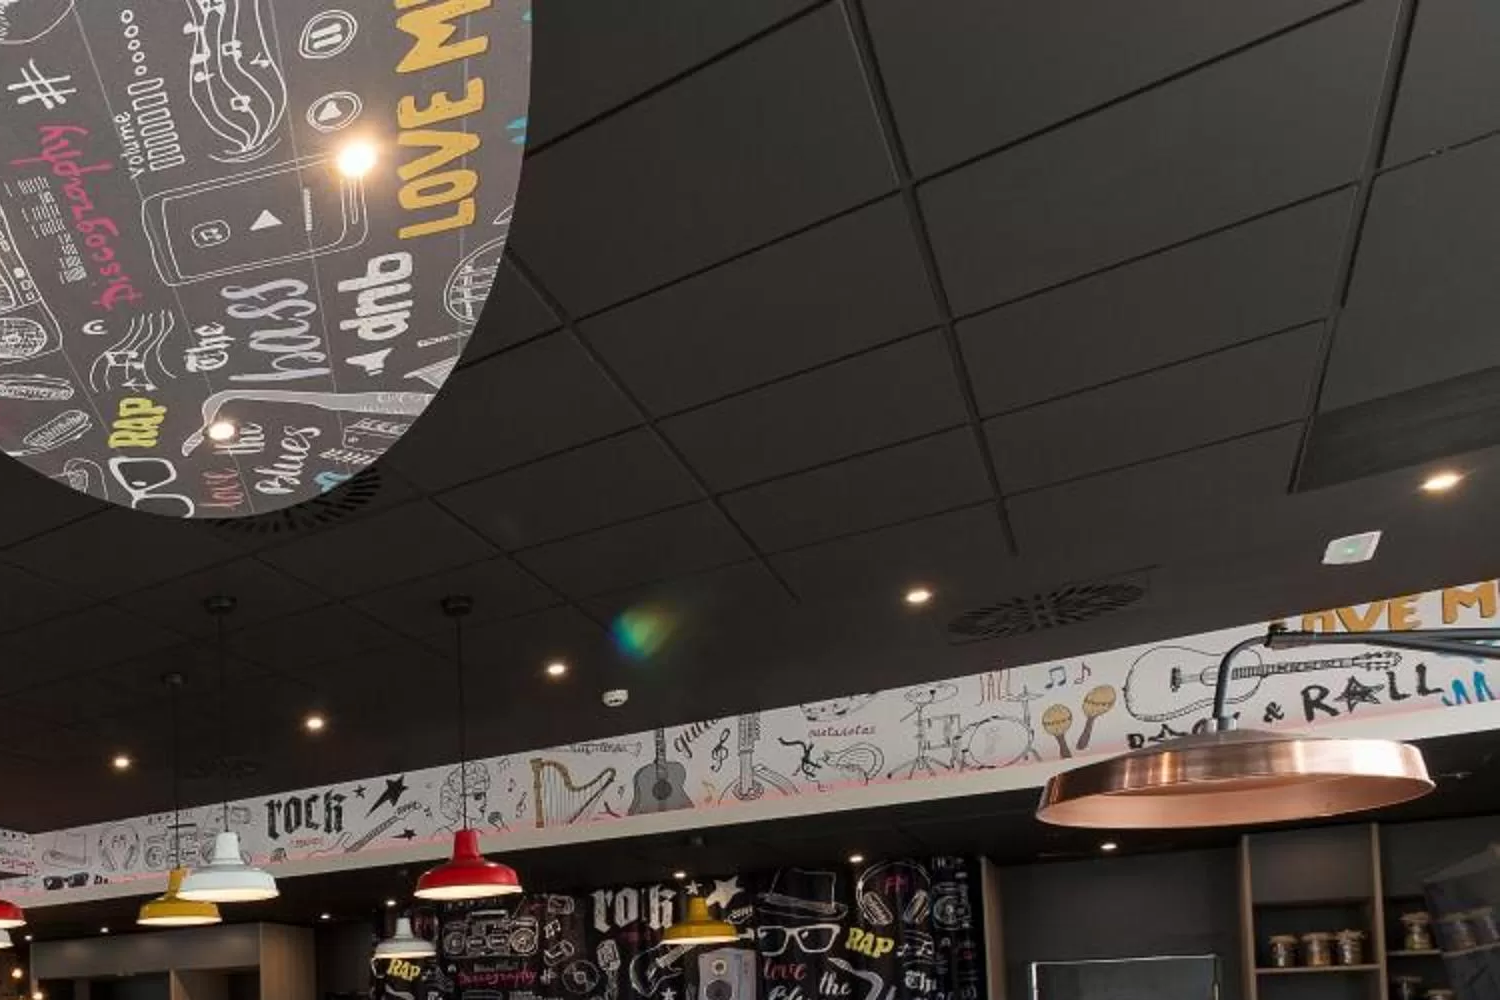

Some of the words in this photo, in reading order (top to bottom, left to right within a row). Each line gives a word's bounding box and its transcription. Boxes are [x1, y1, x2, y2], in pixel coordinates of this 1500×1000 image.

[395, 0, 492, 73] M
[397, 77, 485, 239] LOVE
[11, 121, 143, 310] Discography
[220, 277, 332, 382] bass
[338, 251, 414, 341] dnb
[108, 397, 168, 449] RAP
[1303, 593, 1423, 632] OVE
[1263, 700, 1286, 724] &
[845, 927, 895, 958] RAP
